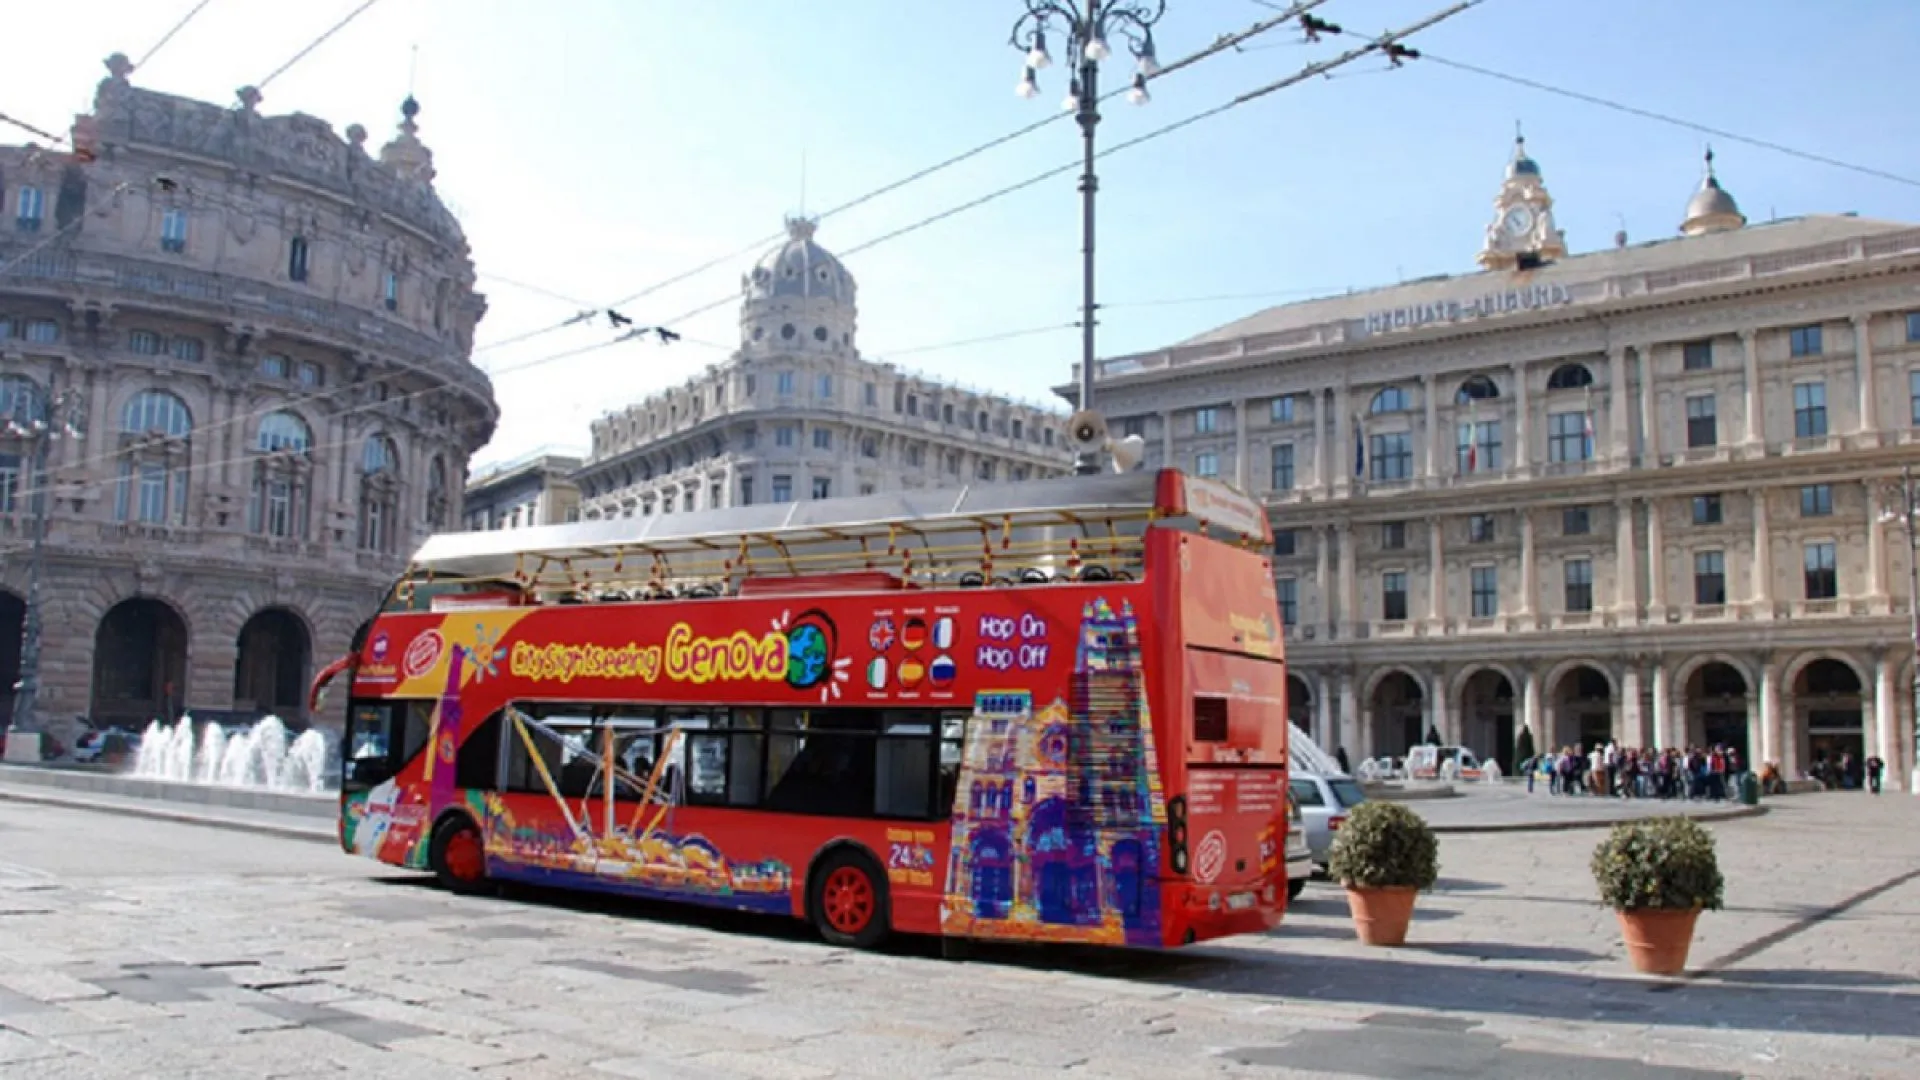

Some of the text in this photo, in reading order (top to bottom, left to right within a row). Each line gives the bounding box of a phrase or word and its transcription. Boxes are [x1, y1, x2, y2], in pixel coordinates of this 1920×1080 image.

[979, 612, 1047, 641] Hop On
[665, 622, 789, 682] Genova
[977, 644, 1049, 670] Hop Off
